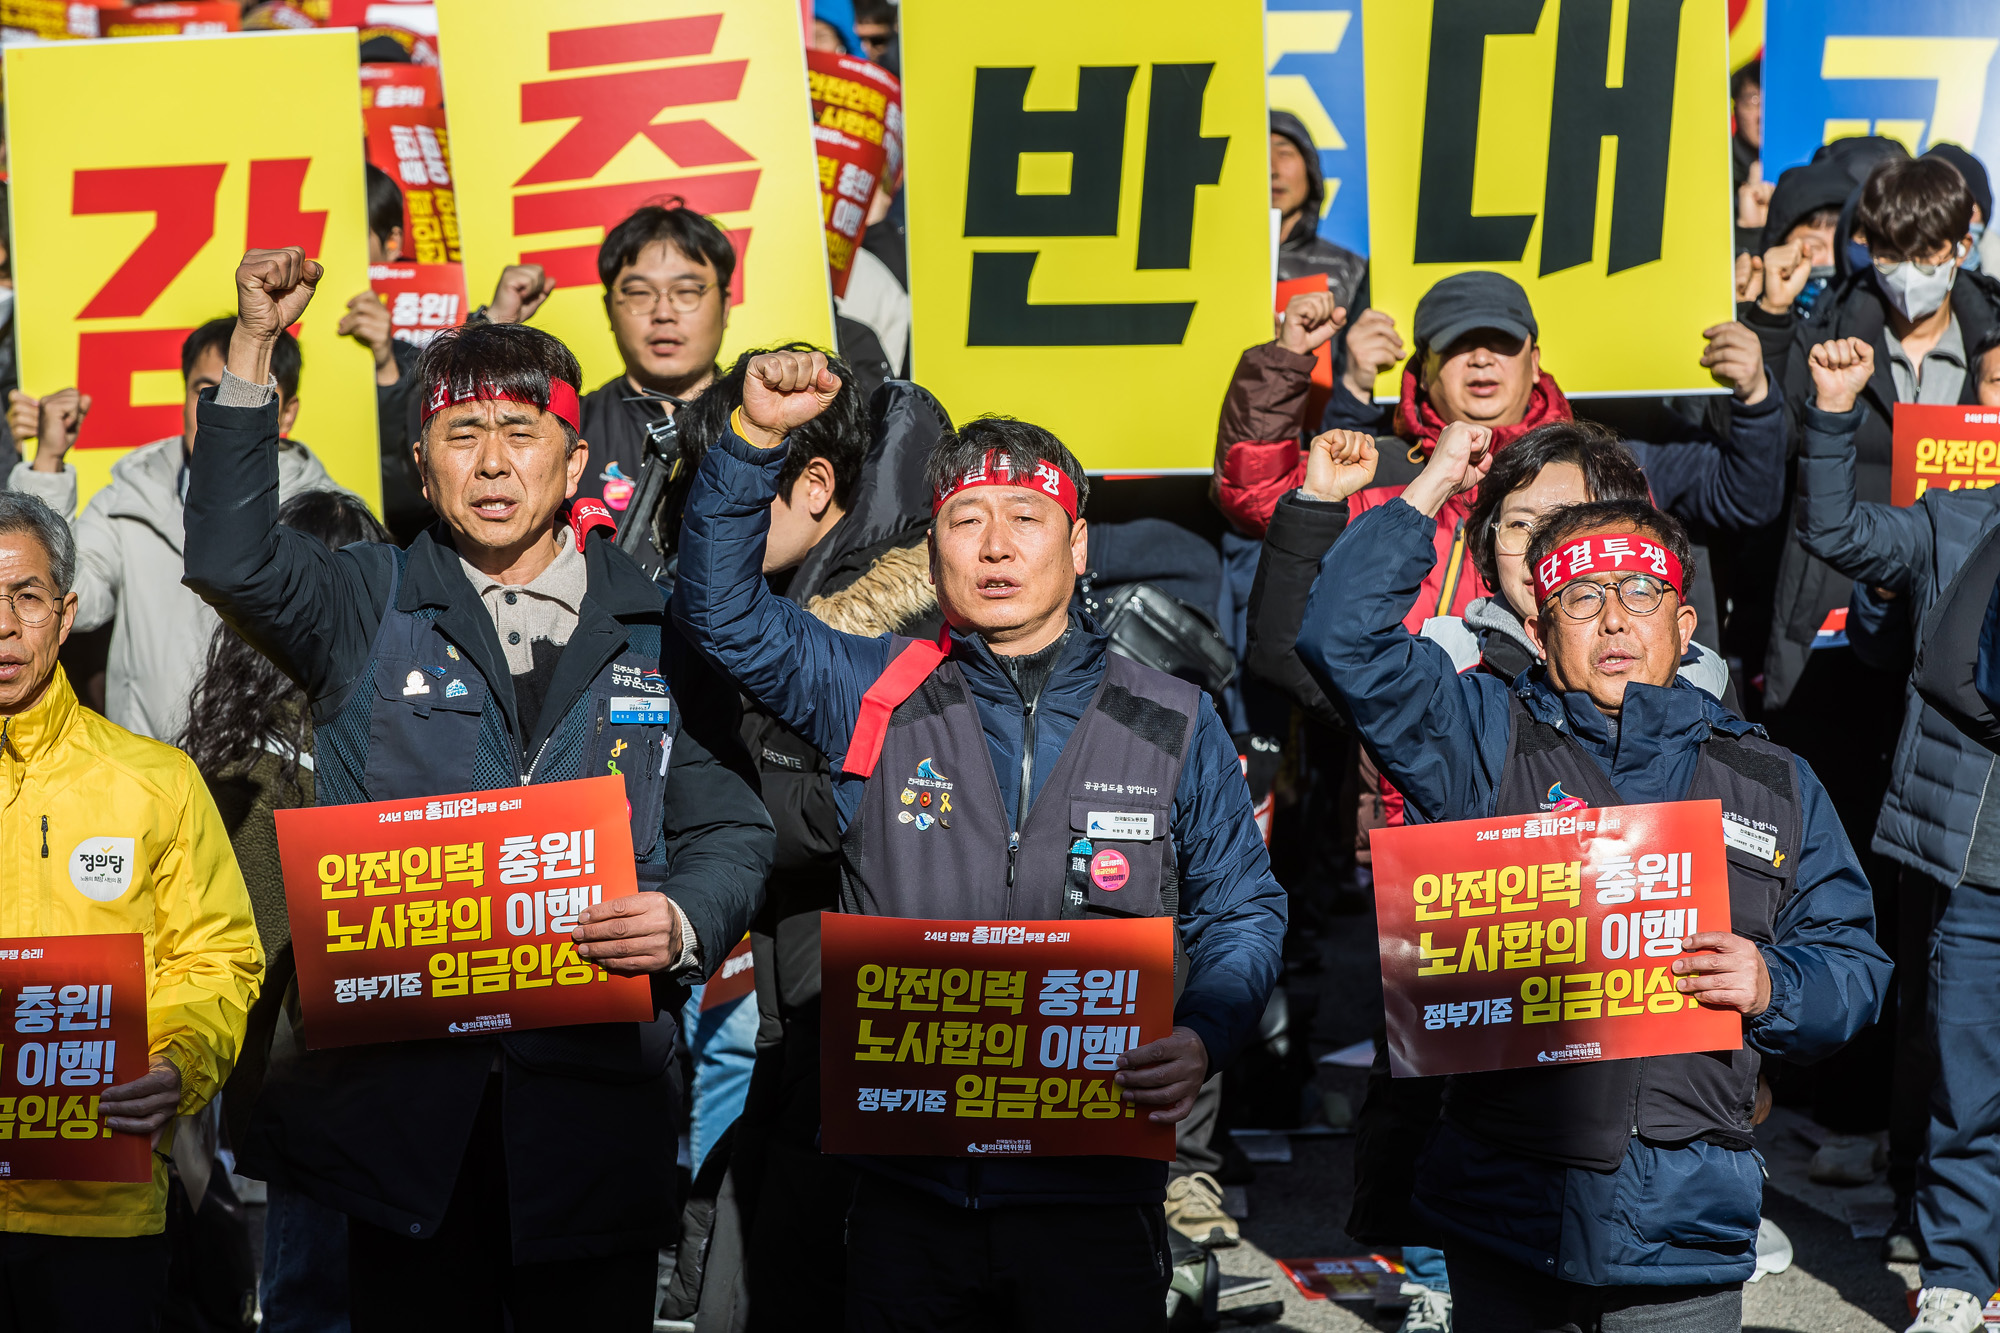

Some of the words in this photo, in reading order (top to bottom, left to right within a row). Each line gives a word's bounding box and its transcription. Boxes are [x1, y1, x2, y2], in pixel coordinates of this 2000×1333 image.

[511, 12, 763, 308] 축
[1413, 0, 1685, 279] 대
[963, 62, 1230, 347] 반
[71, 157, 330, 449] 감
[1539, 537, 1668, 591] 단결투쟁
[613, 664, 641, 676] 민주노총
[379, 811, 401, 823] 24년
[499, 799, 522, 812] 승리!
[1084, 781, 1124, 793] 공공철도를
[1476, 830, 1499, 841] 24년
[79, 854, 125, 874] 정의당
[318, 841, 485, 900] 안전인력
[498, 829, 595, 885] 충원!
[1413, 860, 1582, 922] 안전인력
[1595, 852, 1692, 905] 충원!
[326, 896, 492, 953] 노사합의
[924, 930, 947, 942] 24년
[1047, 931, 1070, 944] 승리!
[1417, 916, 1588, 977] 노사합의
[21, 948, 44, 960] 승리!
[334, 972, 423, 1003] 정부기준
[429, 943, 608, 998] 임금인상
[14, 984, 113, 1034] 충원!
[856, 964, 1028, 1015] 안전인력
[1038, 968, 1139, 1017] 충원!
[1423, 997, 1513, 1030] 정부기준
[1520, 968, 1700, 1025] 임금인상
[16, 1040, 116, 1087] 이행!
[854, 1019, 1028, 1069] 노사합의
[857, 1087, 947, 1113] 정부기준
